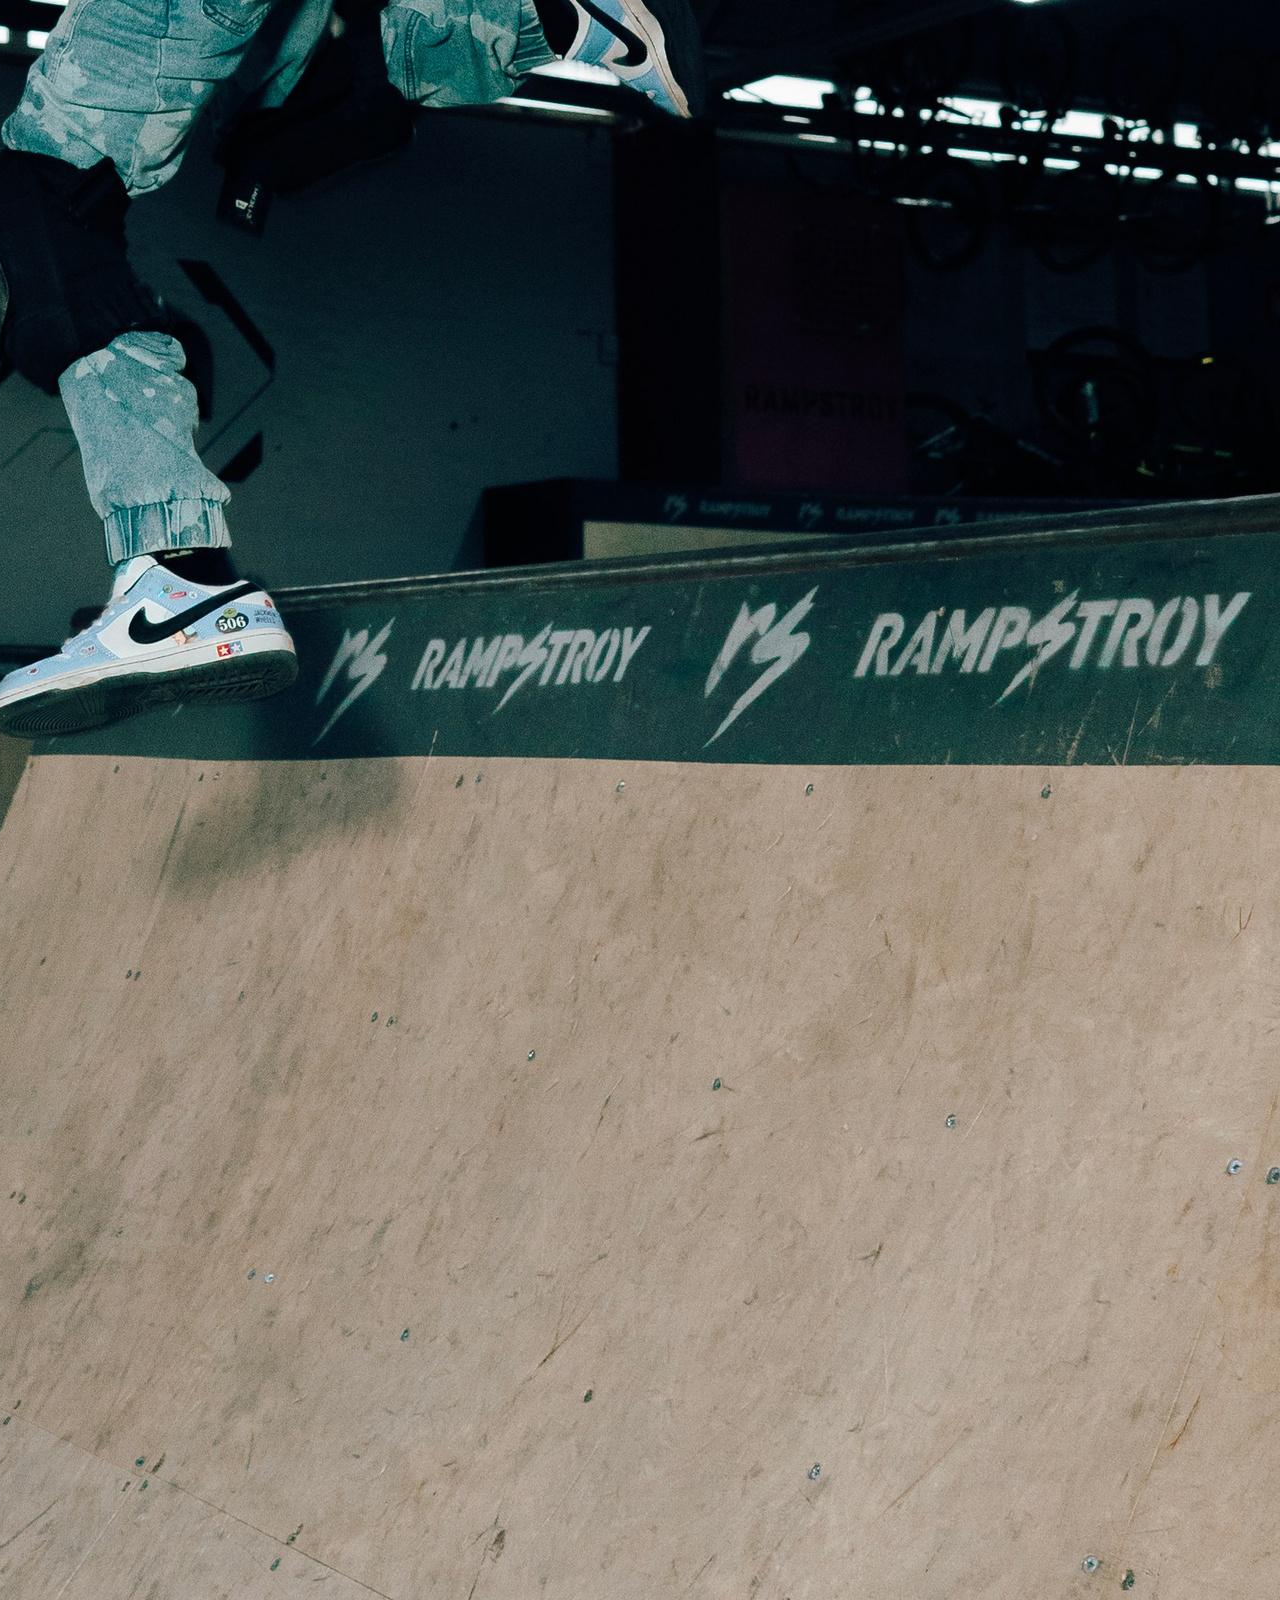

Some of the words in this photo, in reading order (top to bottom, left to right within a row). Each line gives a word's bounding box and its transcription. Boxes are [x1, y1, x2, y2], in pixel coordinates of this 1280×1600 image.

[219, 615, 247, 632] 506
[410, 621, 652, 715] RAMPSTROY
[852, 587, 1253, 708] RAMPSTROY
